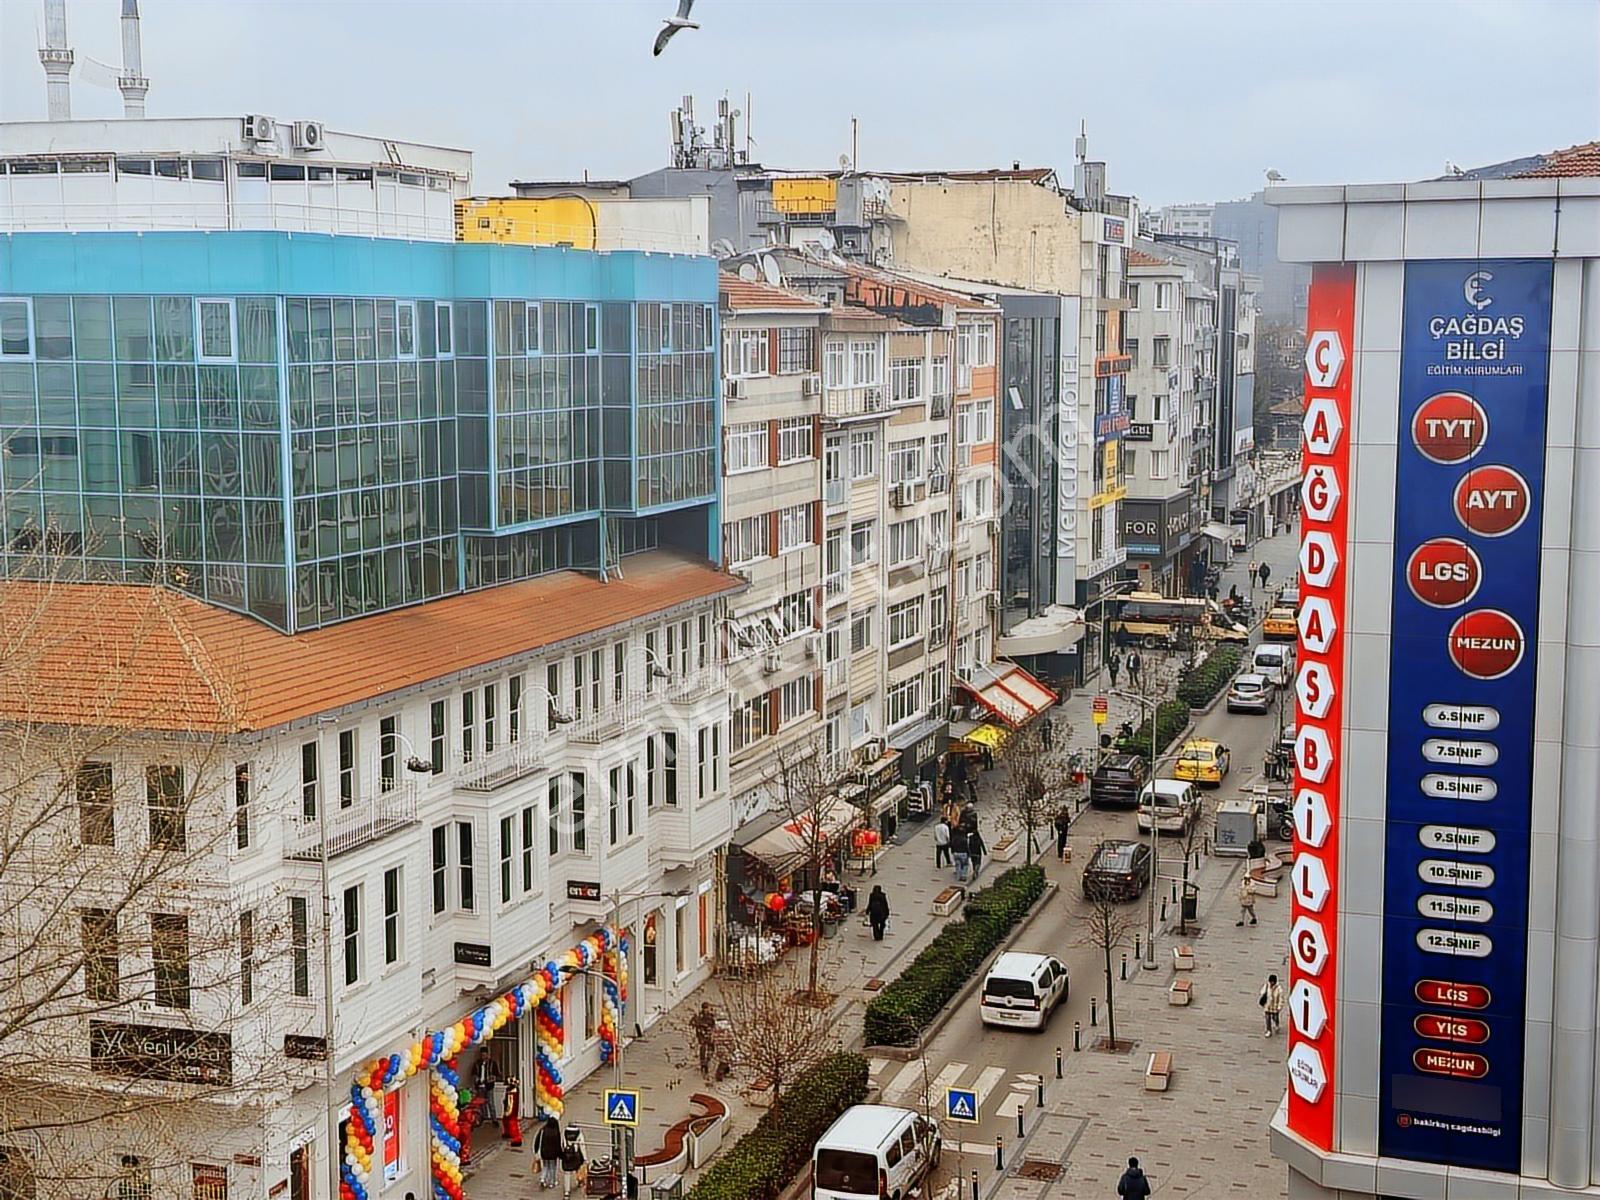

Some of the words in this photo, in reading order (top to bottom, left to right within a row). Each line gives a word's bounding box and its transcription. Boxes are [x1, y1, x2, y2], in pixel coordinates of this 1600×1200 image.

[1430, 313, 1524, 339] ÇAĞDAŞ
[1447, 339, 1504, 360] BİLGİ
[1062, 345, 1078, 425] HOTEL
[1425, 419, 1476, 438] TYT
[1466, 490, 1517, 509] AYT
[1306, 340, 1331, 710] ÇAĞDAŞ
[1419, 562, 1470, 581] LGS
[1457, 637, 1516, 650] MEZUN
[1438, 711, 1485, 723] 6.SINIF
[1437, 746, 1482, 758] 7.SINIF
[1436, 781, 1483, 793] 8.SINIF
[1434, 832, 1480, 845] 9.SINIF
[1430, 867, 1482, 880] 10.SINIF
[1296, 737, 1318, 1032] BİLGİ
[1430, 902, 1480, 915] 11.SINIF
[1427, 936, 1480, 949] 12.SINIF
[1438, 987, 1468, 1002] LGS
[1436, 1021, 1467, 1036] YKS
[1427, 1055, 1474, 1071] MEZUN
